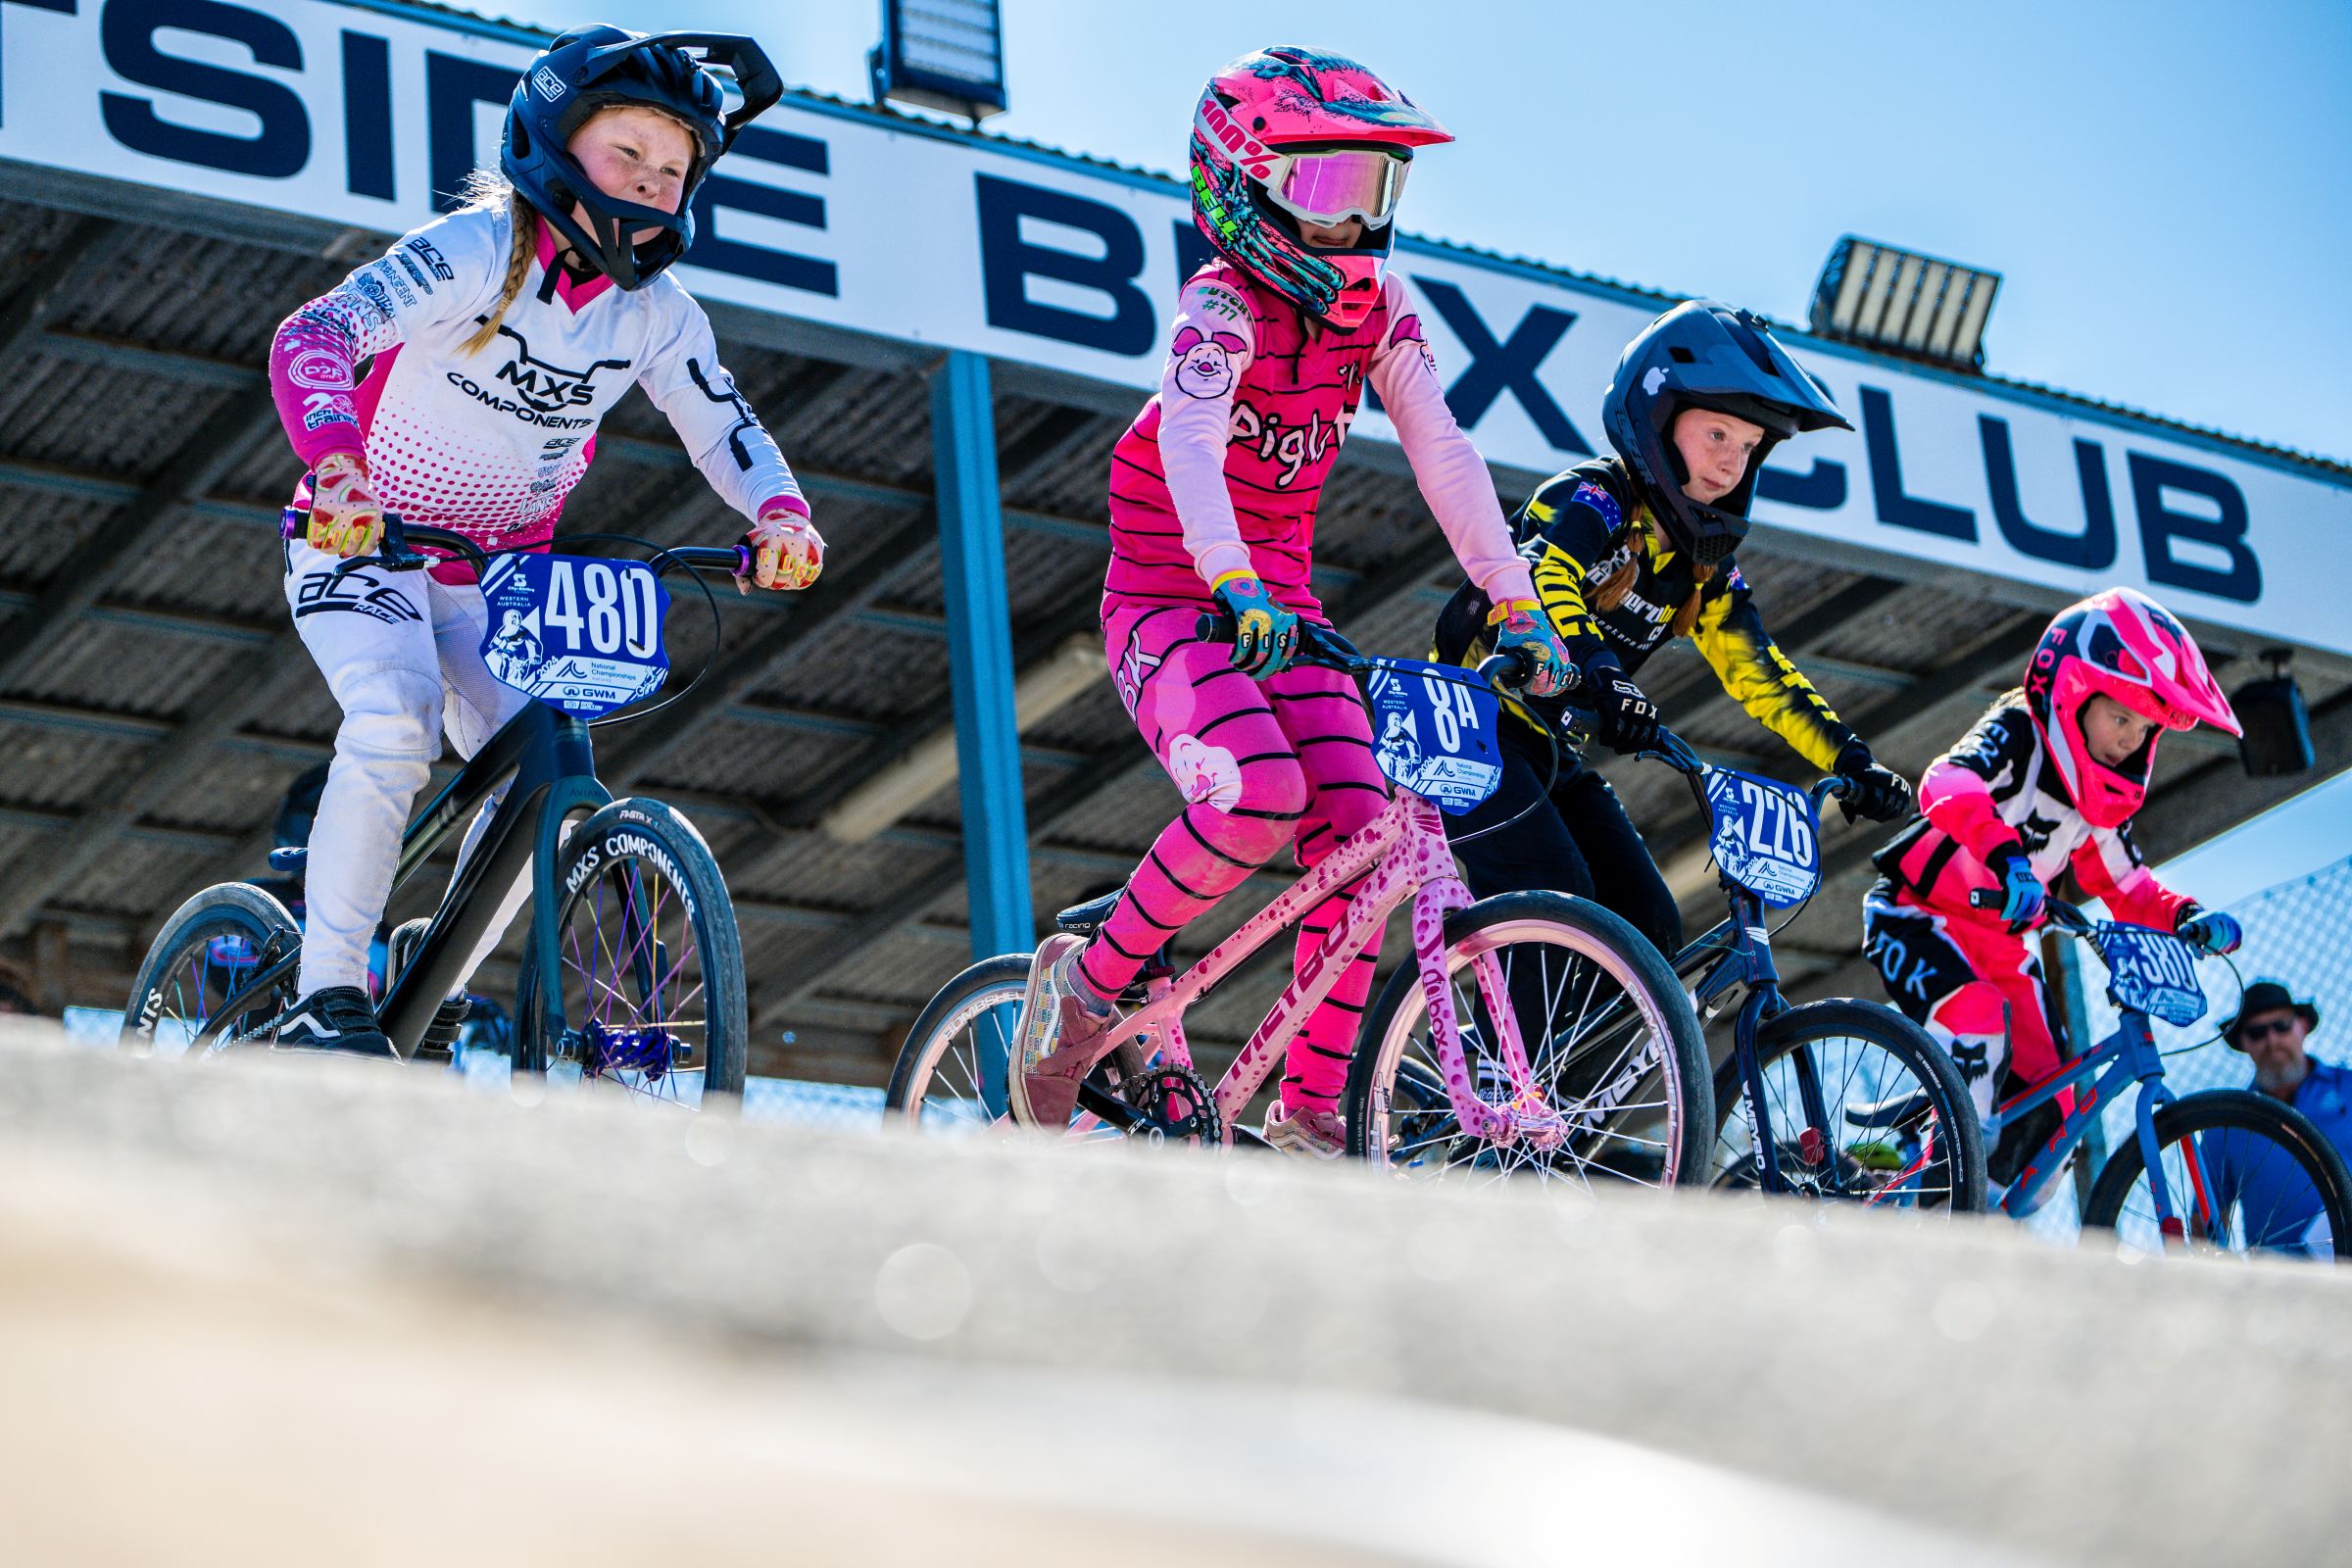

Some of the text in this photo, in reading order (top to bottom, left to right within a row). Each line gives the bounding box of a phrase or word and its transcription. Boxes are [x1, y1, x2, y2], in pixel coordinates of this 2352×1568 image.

[535, 70, 564, 96] ace
[1201, 99, 1281, 180] 100%
[1191, 164, 1239, 242] BELL
[411, 236, 455, 281] ace
[1201, 299, 1239, 322] #77
[446, 371, 596, 429] COMPONENTS
[495, 360, 597, 406] MXS
[306, 409, 332, 421] inch
[297, 571, 424, 621] ace
[353, 604, 401, 625] RACE
[544, 560, 658, 660] 480
[591, 662, 616, 670] National
[591, 668, 637, 681] Championships
[2031, 626, 2068, 698] FOX
[582, 688, 616, 700] GWM
[1422, 667, 1480, 754] 8A
[1620, 698, 1658, 720] FOX
[1453, 786, 1477, 798] GWM
[1740, 780, 1813, 867] 226
[565, 833, 696, 922] MXS COMPONENTS
[1744, 1099, 1766, 1171] MEYBO
